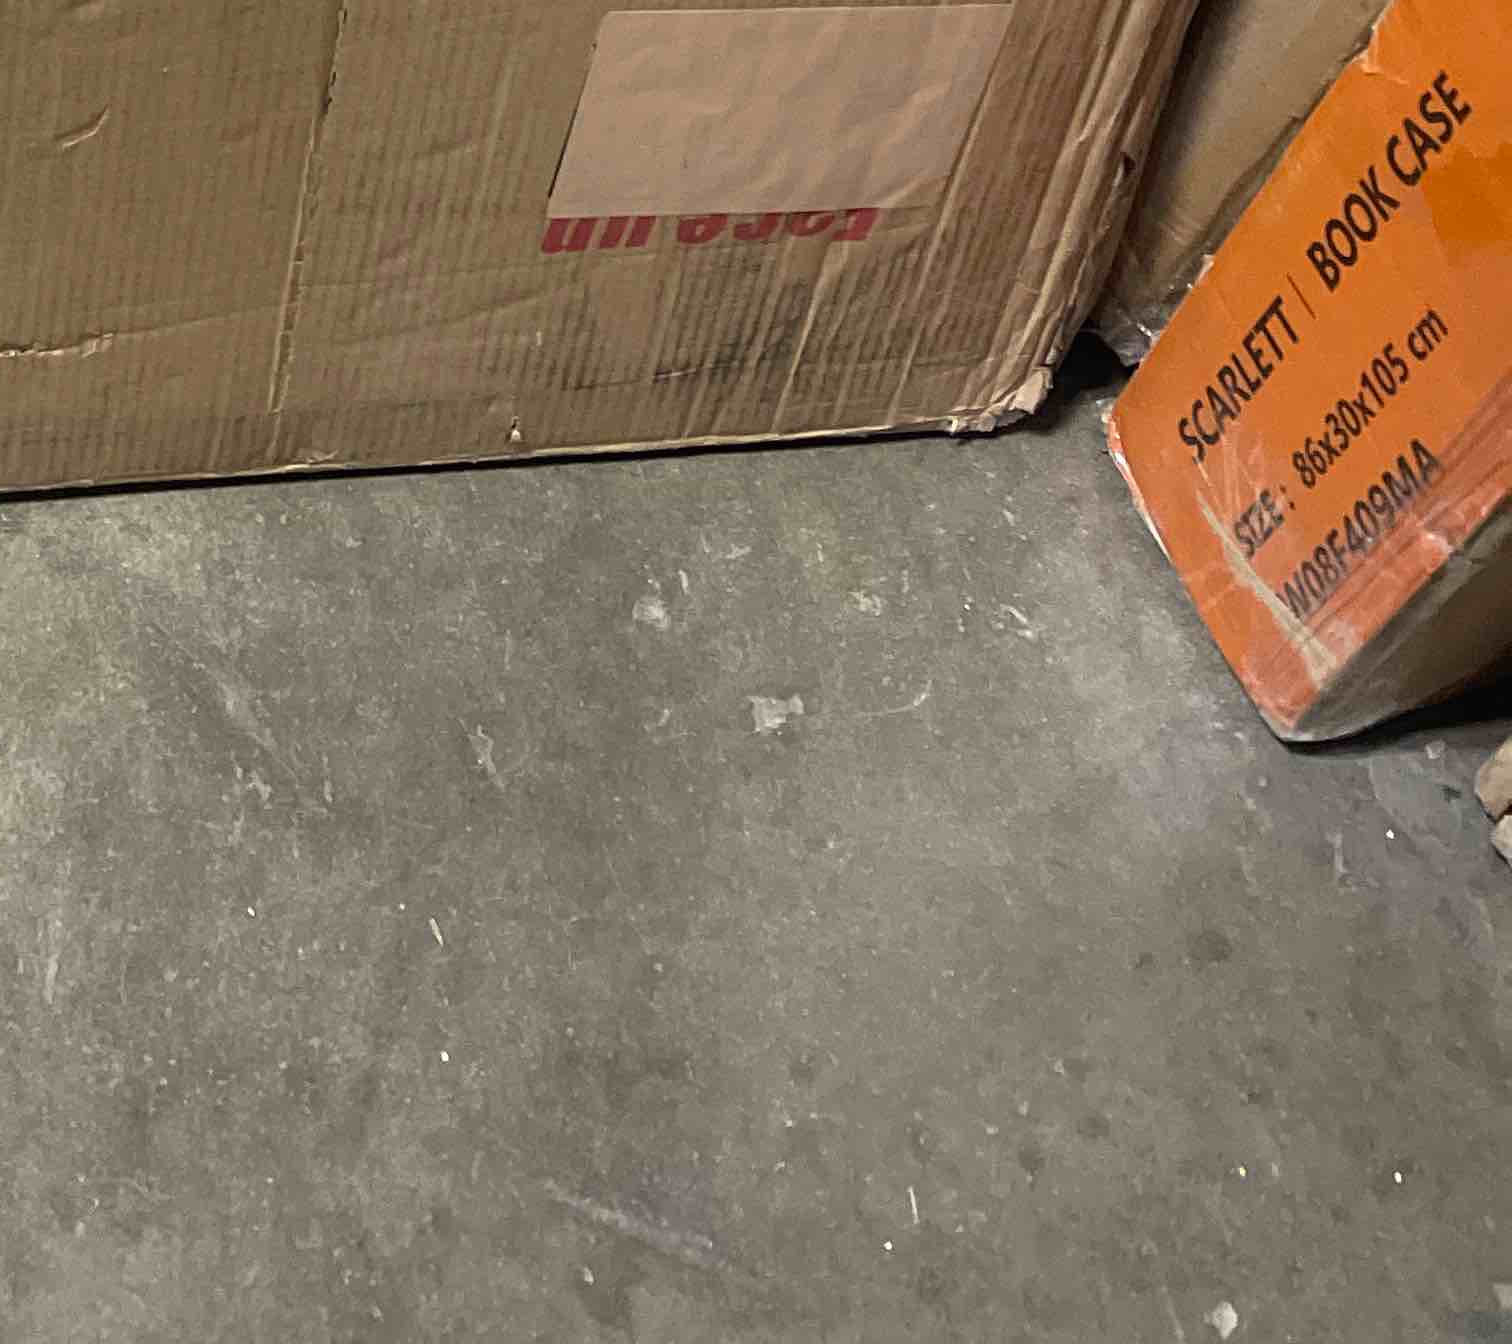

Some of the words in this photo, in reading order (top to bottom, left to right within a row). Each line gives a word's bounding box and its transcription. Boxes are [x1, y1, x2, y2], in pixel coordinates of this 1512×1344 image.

[1177, 294, 1300, 464] SCARLETT
[1306, 164, 1401, 294] BOOK
[1386, 69, 1473, 188] CASE
[1291, 340, 1410, 490] 86x30x105
[1407, 307, 1450, 363] cm
